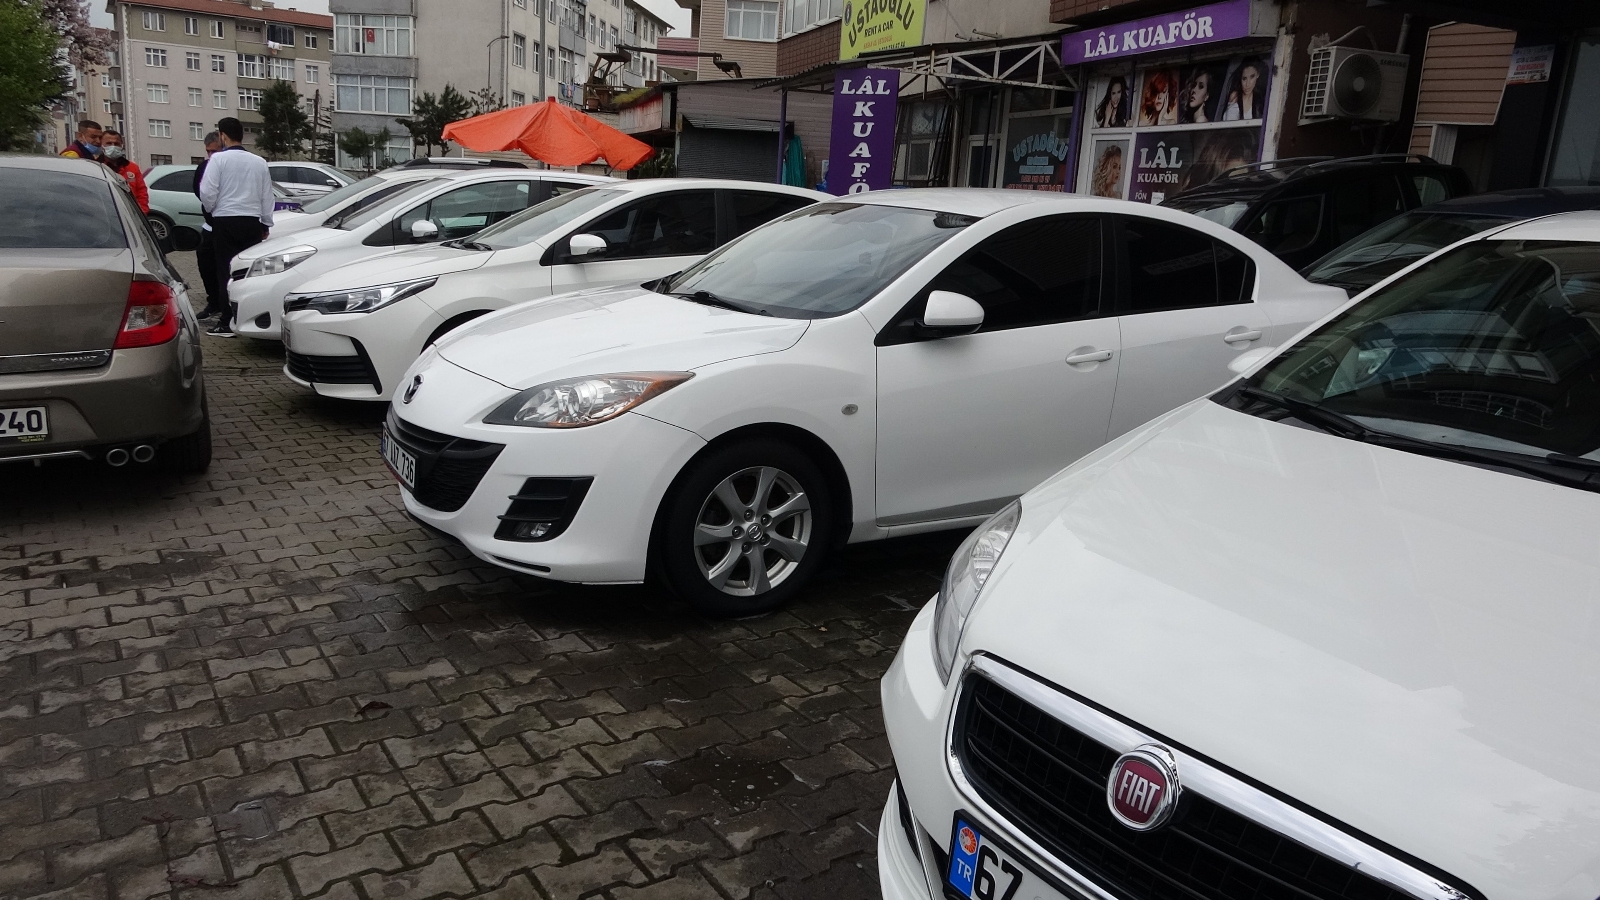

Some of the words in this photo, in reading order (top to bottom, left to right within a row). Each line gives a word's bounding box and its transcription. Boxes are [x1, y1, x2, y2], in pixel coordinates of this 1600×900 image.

[864, 25, 877, 38] RENT
[877, 26, 882, 34] A
[882, 19, 894, 33] CAR
[1084, 31, 1119, 58] LÂL
[1122, 12, 1214, 52] KUAFÖR
[840, 75, 891, 95] LÂL
[1012, 130, 1069, 162] USTAOĞLU
[1138, 140, 1183, 169] LÂL
[1136, 170, 1179, 184] KUAFÖR
[402, 452, 415, 484] 736
[1117, 769, 1161, 814] FIAT
[956, 857, 972, 883] TR
[973, 845, 1024, 900] 67
